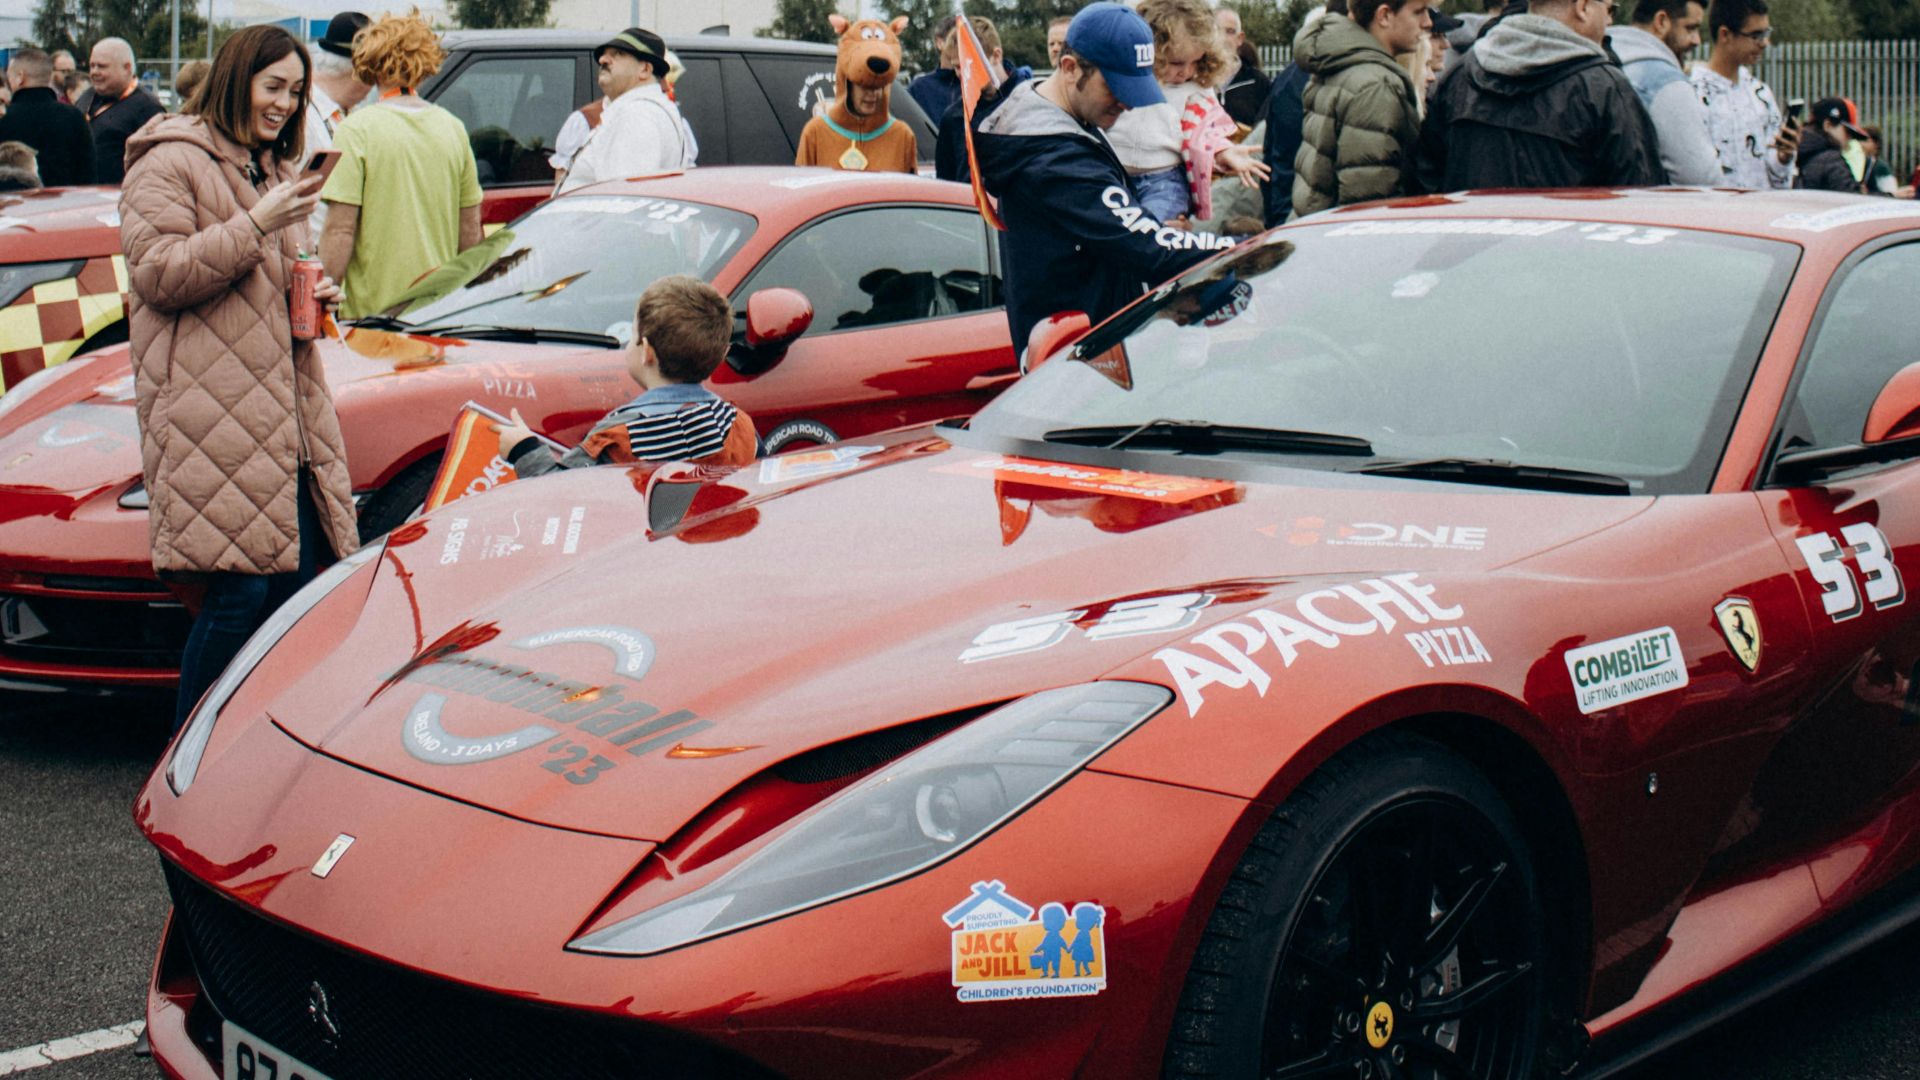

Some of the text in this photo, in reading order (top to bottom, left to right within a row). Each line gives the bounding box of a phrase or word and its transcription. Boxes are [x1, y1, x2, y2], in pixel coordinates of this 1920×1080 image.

[483, 377, 537, 399] PIZZA
[799, 424, 823, 437] ROAD
[1795, 521, 1905, 623] 53
[957, 591, 1216, 664] 53
[1152, 572, 1464, 719] APACHE
[1404, 626, 1493, 668] PIZZA
[1621, 669, 1679, 695] INNOVATION
[414, 710, 441, 751] IRELAND
[466, 737, 517, 756] DAYS
[966, 912, 1003, 922] PROUDLY
[967, 918, 1018, 930] SUPPORTING
[960, 932, 1018, 955] JACK
[961, 956, 1026, 977] AND JILL
[960, 983, 1096, 999] CHILDREN'S FOUNDATION
